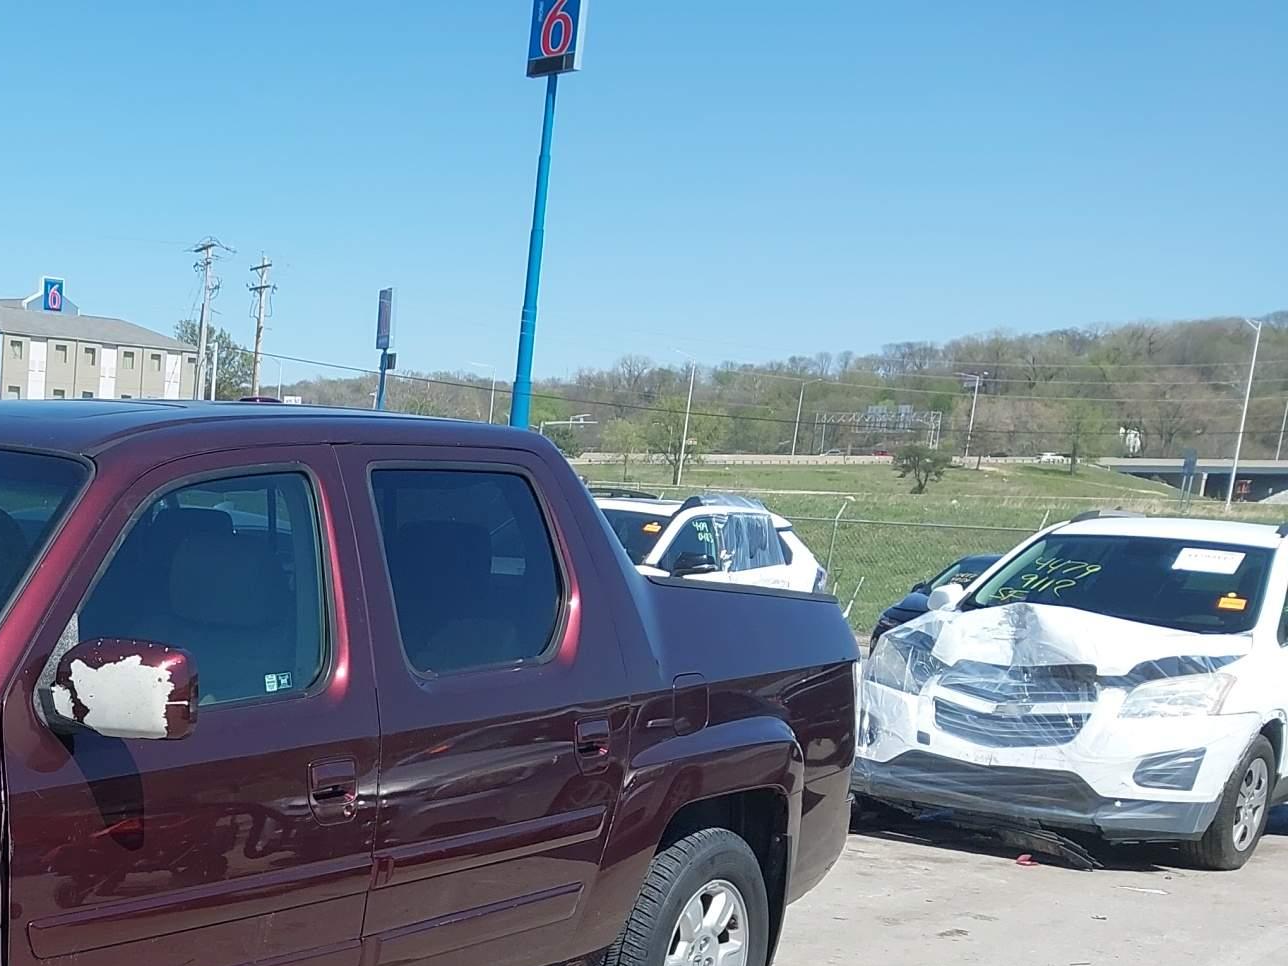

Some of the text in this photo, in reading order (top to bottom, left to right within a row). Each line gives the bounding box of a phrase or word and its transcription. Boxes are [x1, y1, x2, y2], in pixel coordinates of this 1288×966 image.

[540, 0, 574, 57] 6
[48, 284, 61, 309] 6
[1035, 556, 1102, 579] 4479
